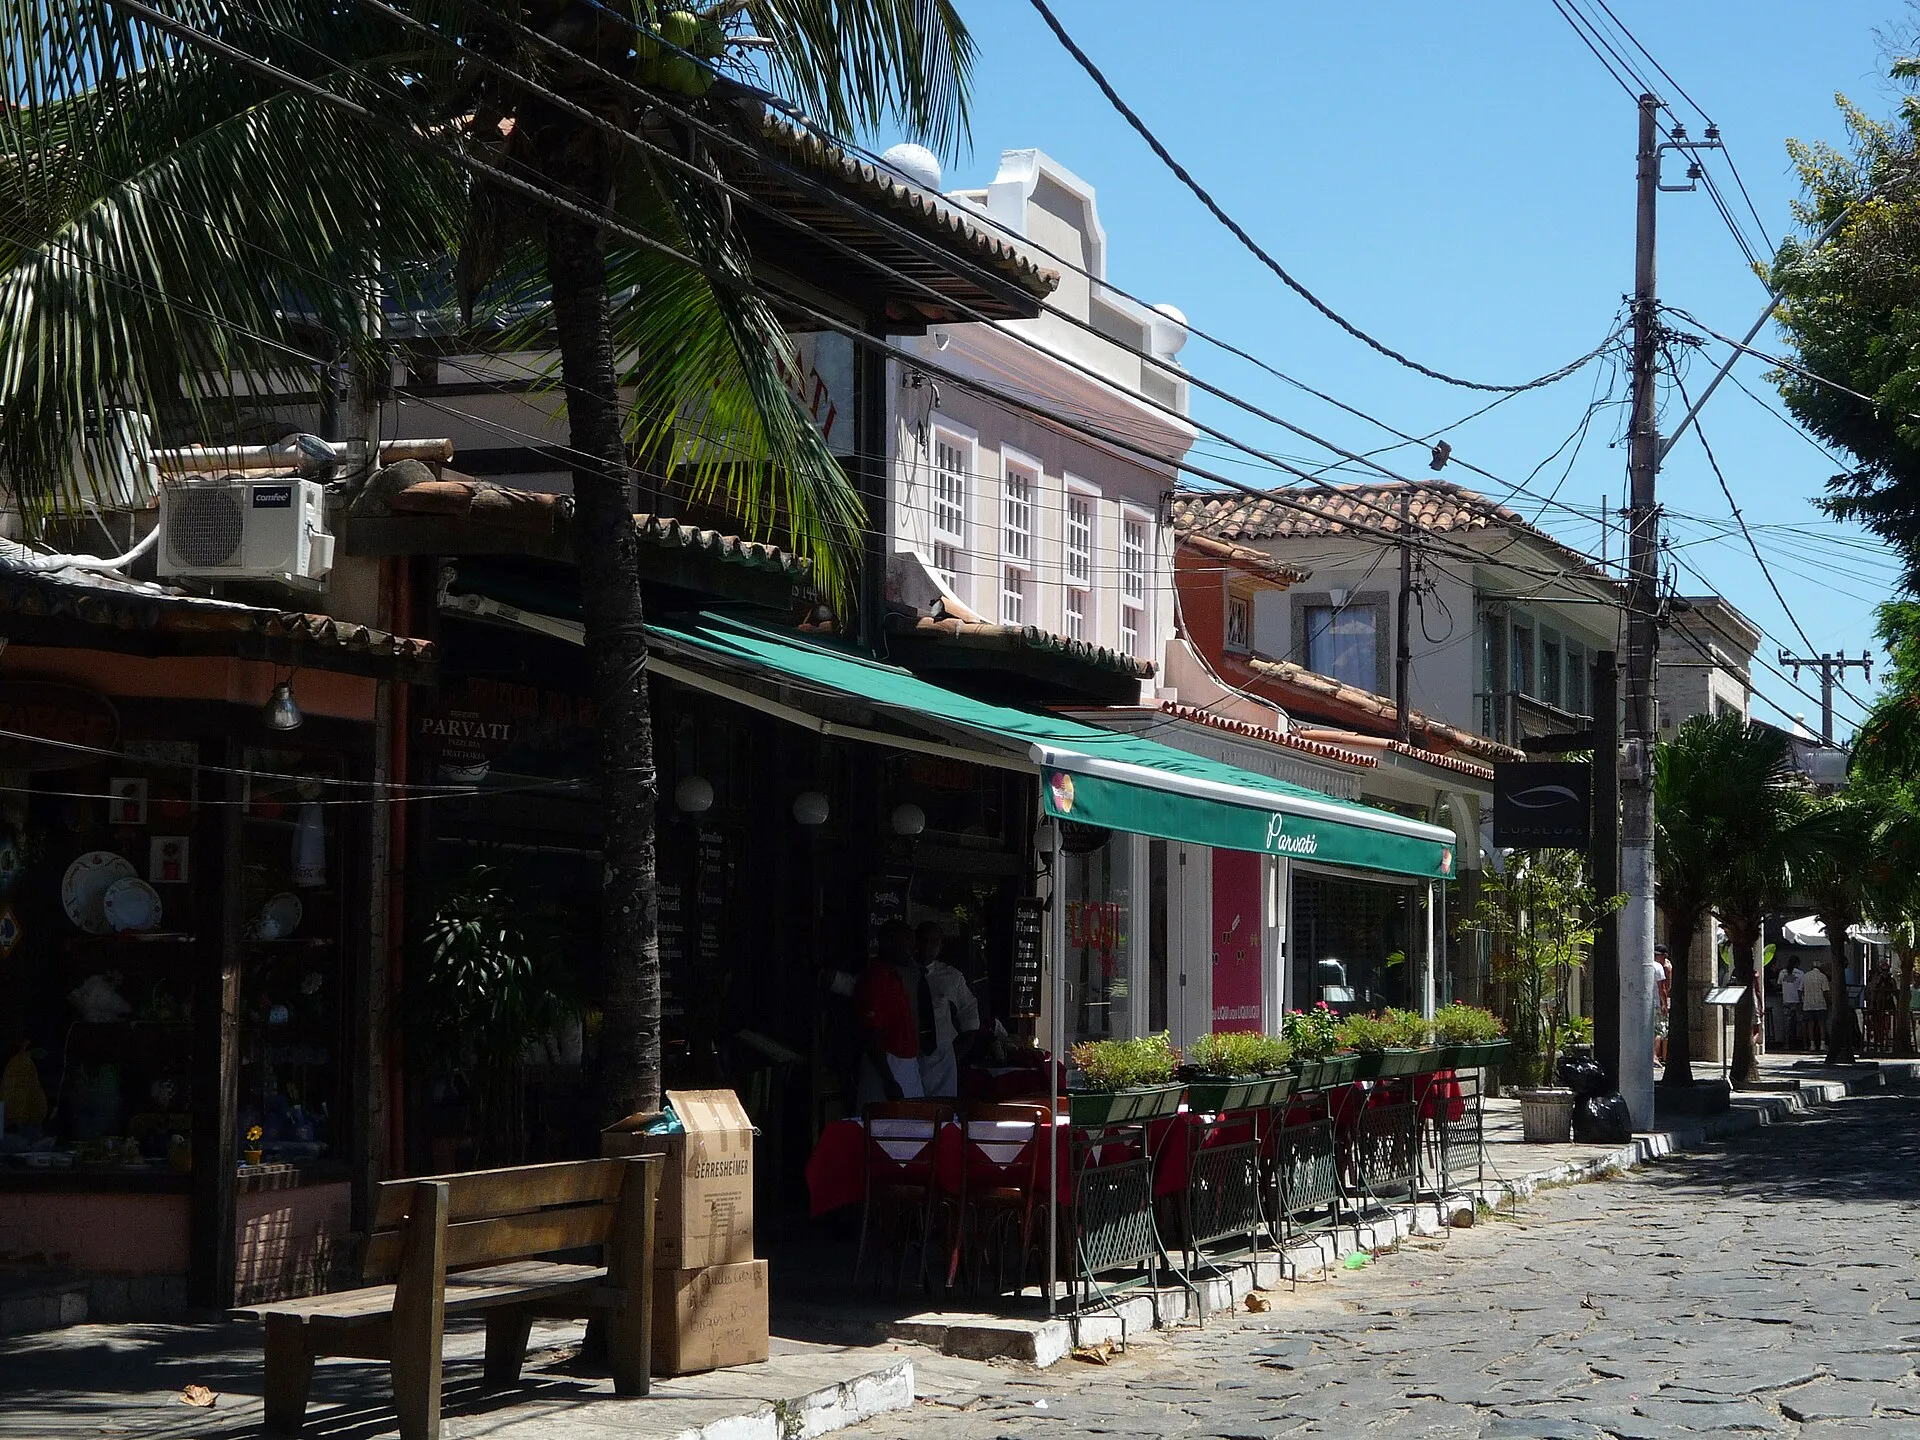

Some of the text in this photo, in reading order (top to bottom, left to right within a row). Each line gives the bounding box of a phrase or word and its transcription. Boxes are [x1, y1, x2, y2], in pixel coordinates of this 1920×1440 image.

[421, 717, 512, 741] PARVATI
[1266, 811, 1318, 854] Parvati
[695, 1153, 748, 1179] GERRESHEIMER
